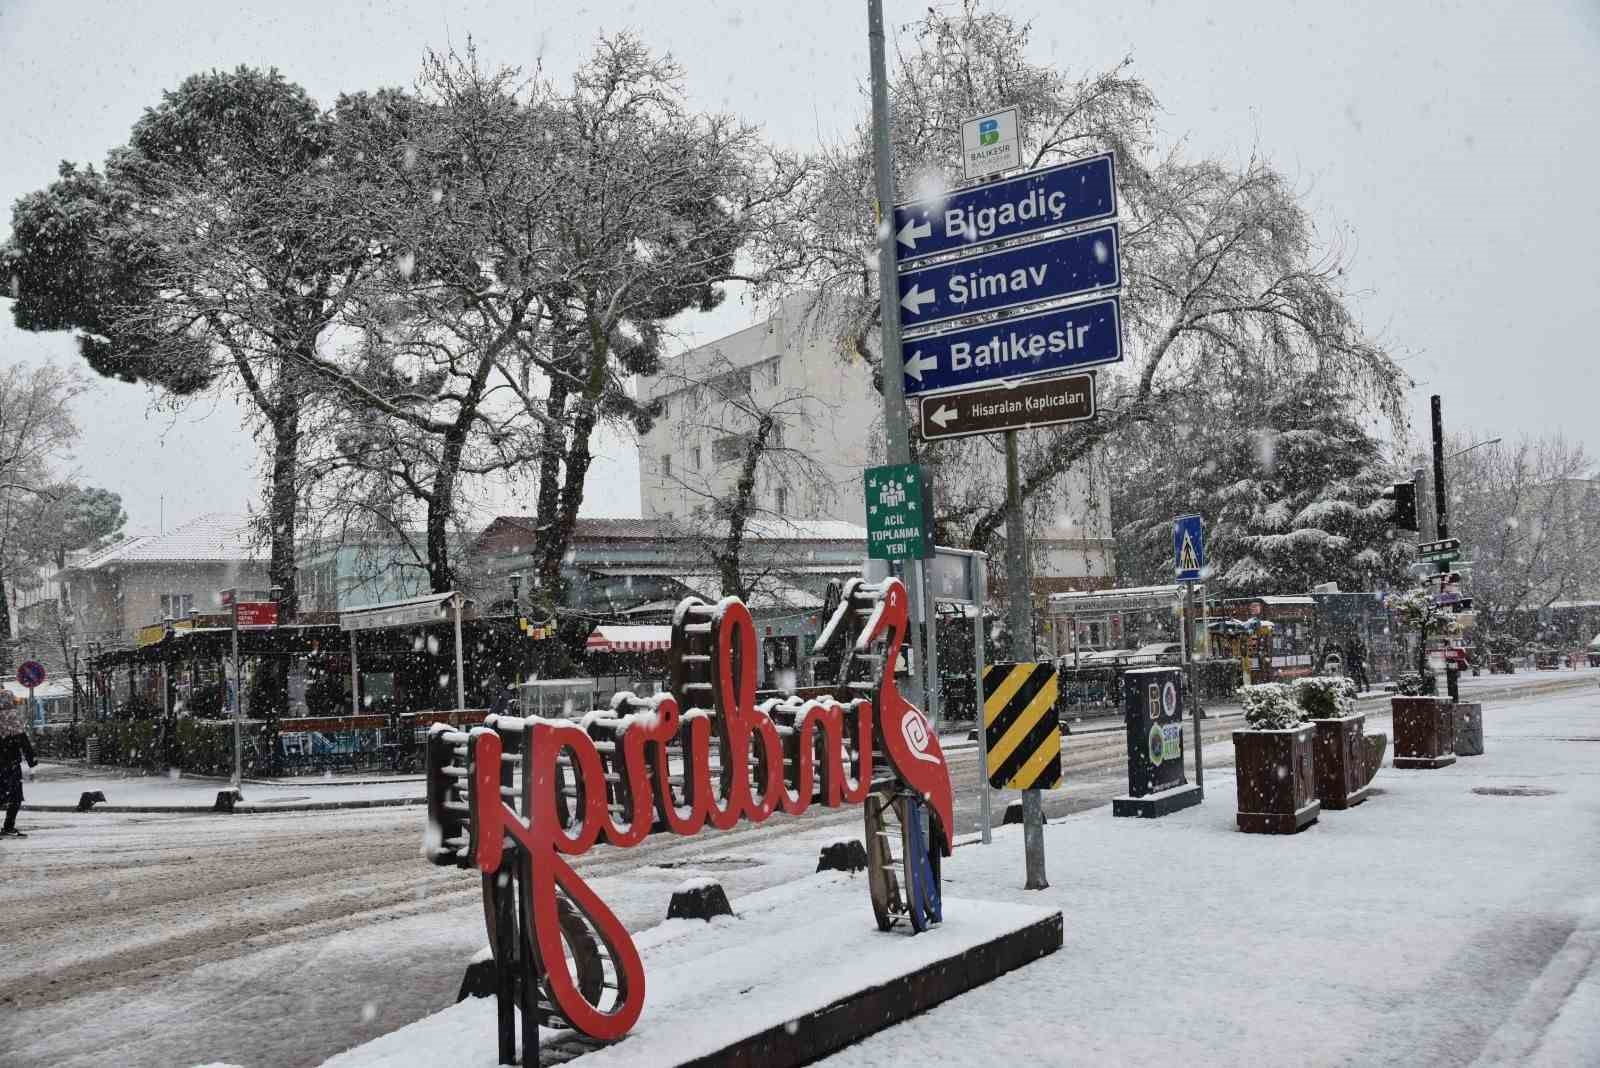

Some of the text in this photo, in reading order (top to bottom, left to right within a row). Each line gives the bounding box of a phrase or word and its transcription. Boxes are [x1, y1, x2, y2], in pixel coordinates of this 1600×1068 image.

[945, 188, 1067, 238] Bigadiç
[949, 264, 1048, 304] Simav
[972, 400, 1021, 417] Hisaralan
[871, 527, 920, 541] TOPLANMA
